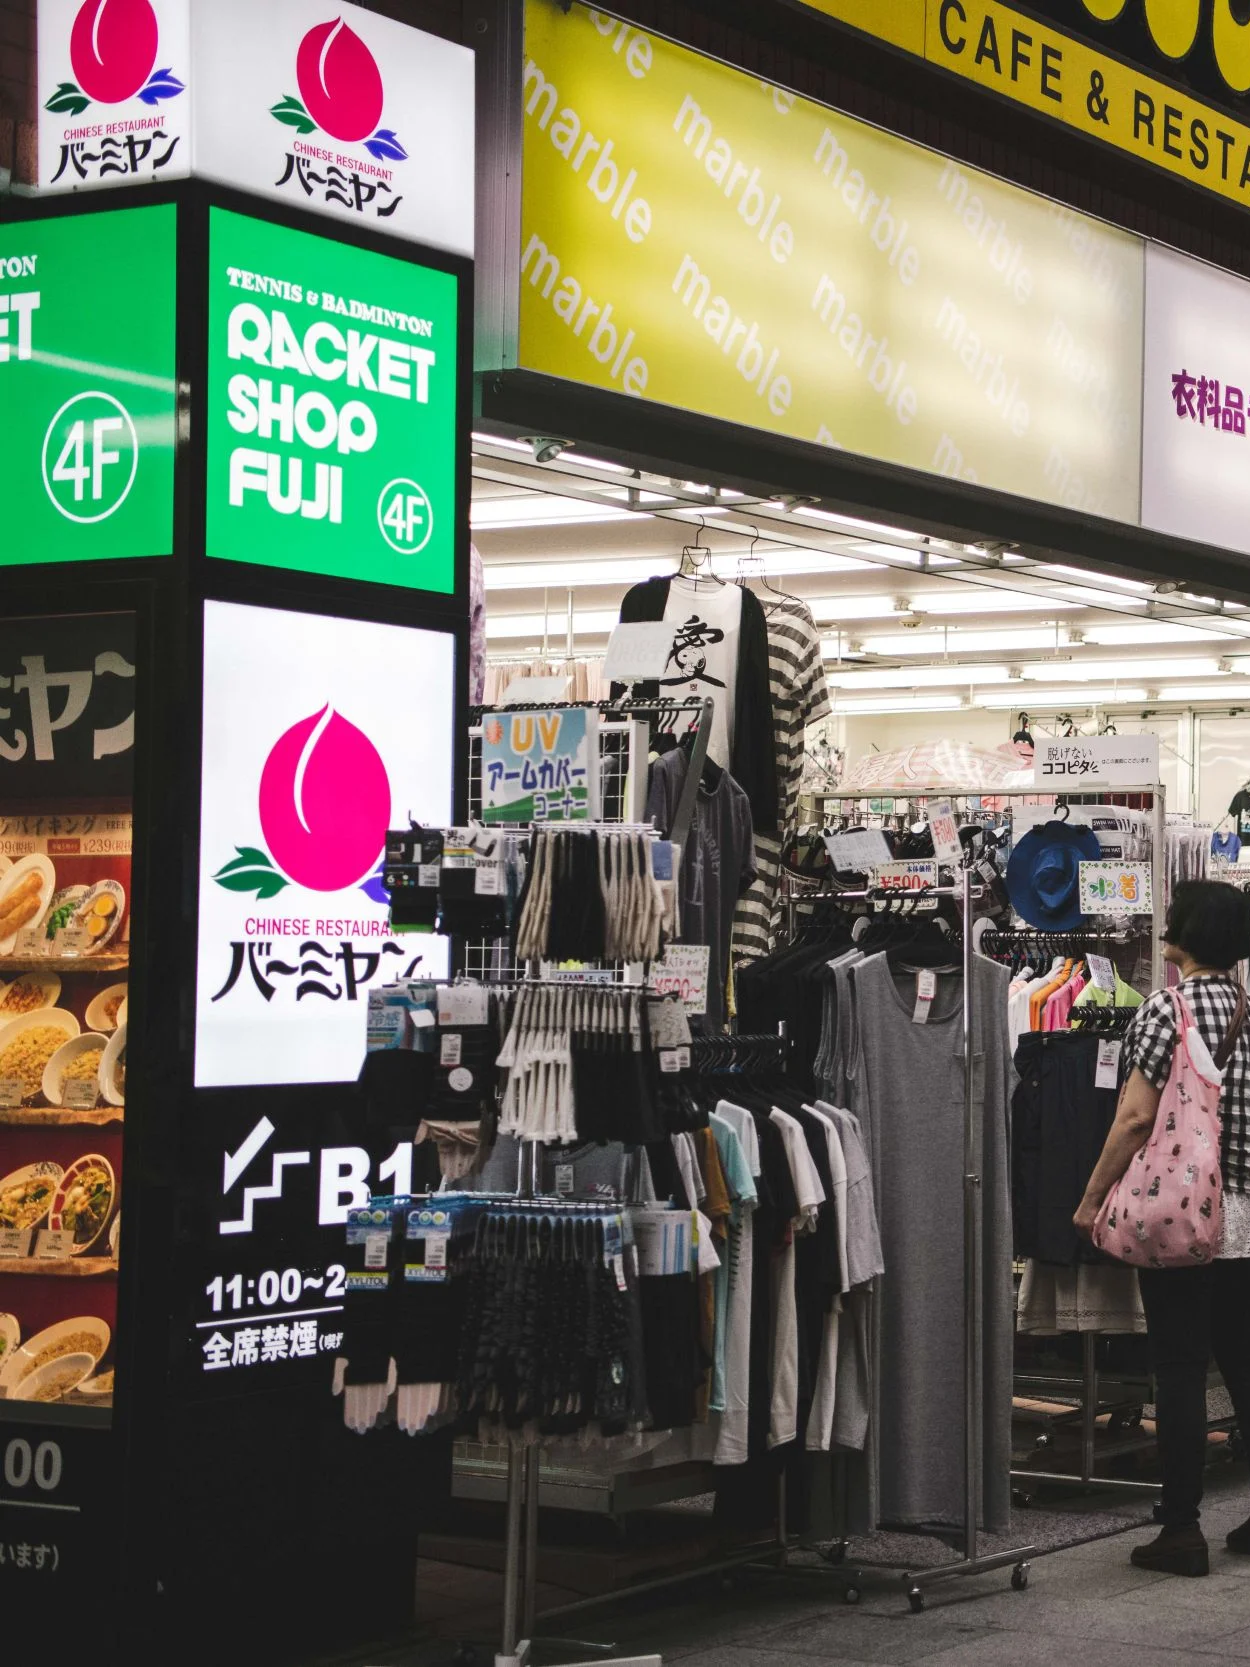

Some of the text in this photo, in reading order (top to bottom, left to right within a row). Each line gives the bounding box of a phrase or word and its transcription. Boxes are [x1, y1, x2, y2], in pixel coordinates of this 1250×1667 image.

[939, 0, 1063, 102] CAFE
[1086, 69, 1110, 126] &
[50, 131, 180, 184] バーミヤン
[63, 115, 166, 141] CHINESE RESTAURANT
[293, 140, 394, 182] CHINESE RESTAURANT
[523, 60, 652, 243] marble
[275, 152, 403, 217] バーミヤン
[673, 93, 795, 264] marble
[814, 127, 920, 286] marble
[227, 267, 434, 338] TENNIS & BADMINTON
[521, 233, 649, 397] marble
[672, 253, 792, 417] marble
[227, 303, 436, 405] RACKET
[811, 273, 918, 426] marble
[935, 296, 1031, 438] marble
[227, 374, 378, 455] SHOP
[53, 417, 124, 502] 4F
[228, 447, 344, 525] FUJI
[383, 493, 426, 543] 4F
[512, 714, 561, 753] UV
[1047, 746, 1093, 761] 脱げない
[488, 757, 586, 792] アームカバー
[535, 793, 586, 818] コーナー
[245, 917, 405, 937] CHINESE RESTAURA
[319, 1142, 413, 1226] B1
[347, 1210, 392, 1225] COOL
[407, 1210, 452, 1226] COOL
[206, 1264, 347, 1312] 11:00~2
